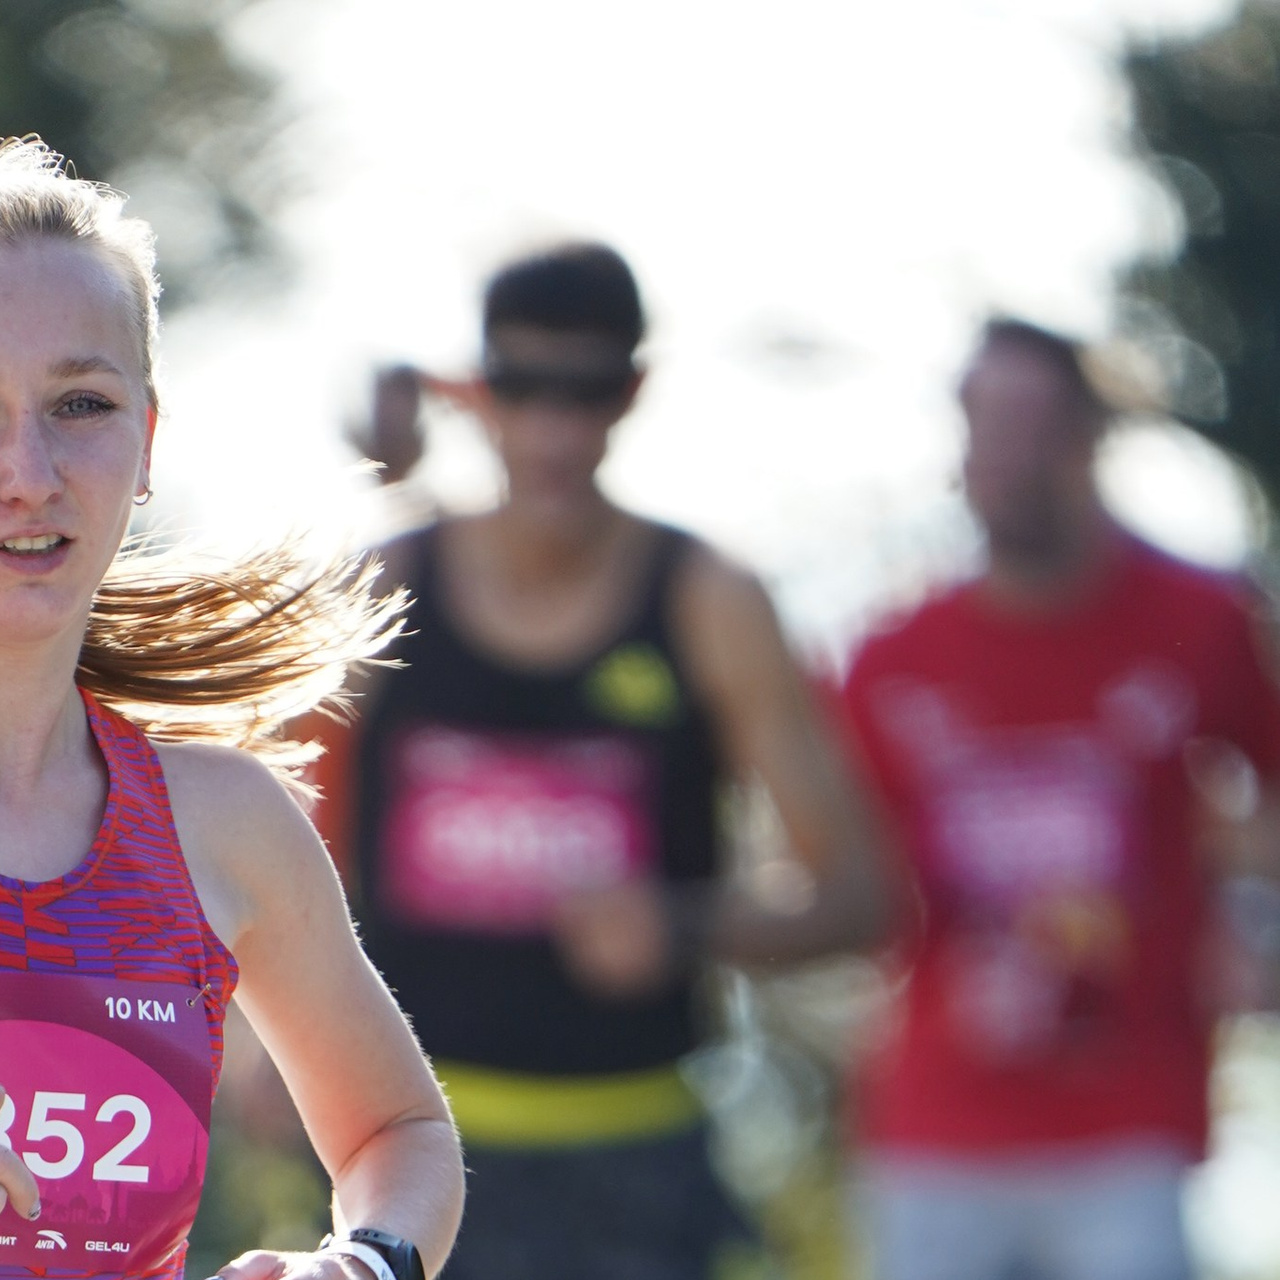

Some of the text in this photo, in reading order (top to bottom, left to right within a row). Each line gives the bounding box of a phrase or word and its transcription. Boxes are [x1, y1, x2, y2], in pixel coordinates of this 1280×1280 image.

[105, 997, 176, 1023] 10 KM
[34, 1239, 56, 1250] ANTA
[84, 1240, 131, 1253] GEL4U
